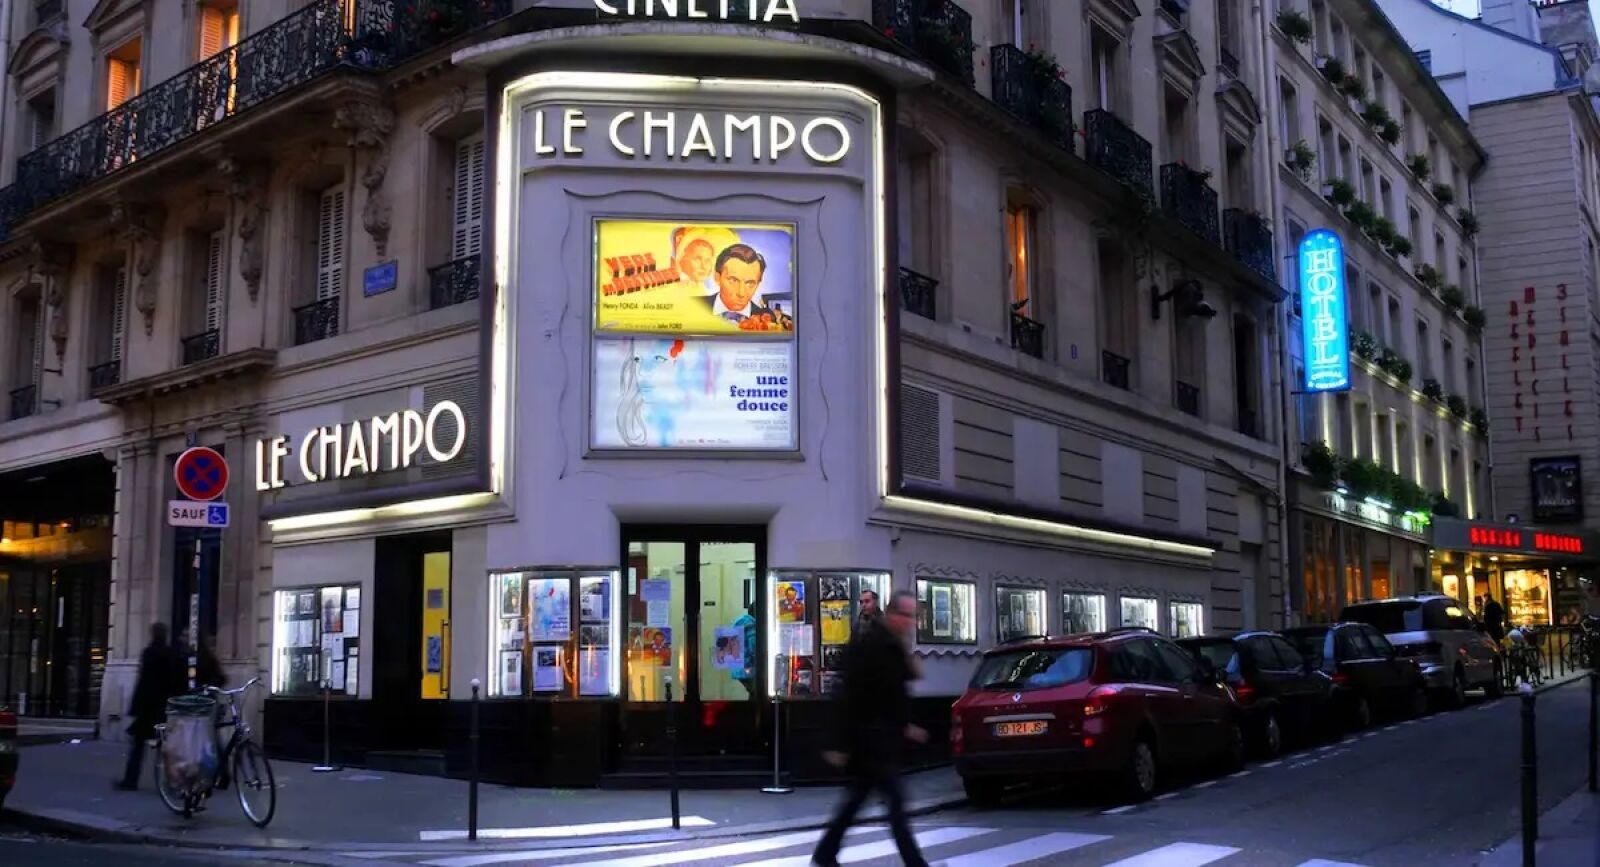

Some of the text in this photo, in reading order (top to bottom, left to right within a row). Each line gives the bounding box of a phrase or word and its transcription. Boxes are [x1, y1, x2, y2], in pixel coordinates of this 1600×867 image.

[534, 109, 850, 163] LE CHAMPO
[1556, 284, 1568, 300] 3
[1304, 248, 1340, 364] HOTEL
[756, 375, 788, 385] une
[729, 385, 788, 398] femme
[737, 399, 788, 411] douce
[256, 400, 466, 491] LE CHAMPO
[172, 507, 207, 521] SAUF
